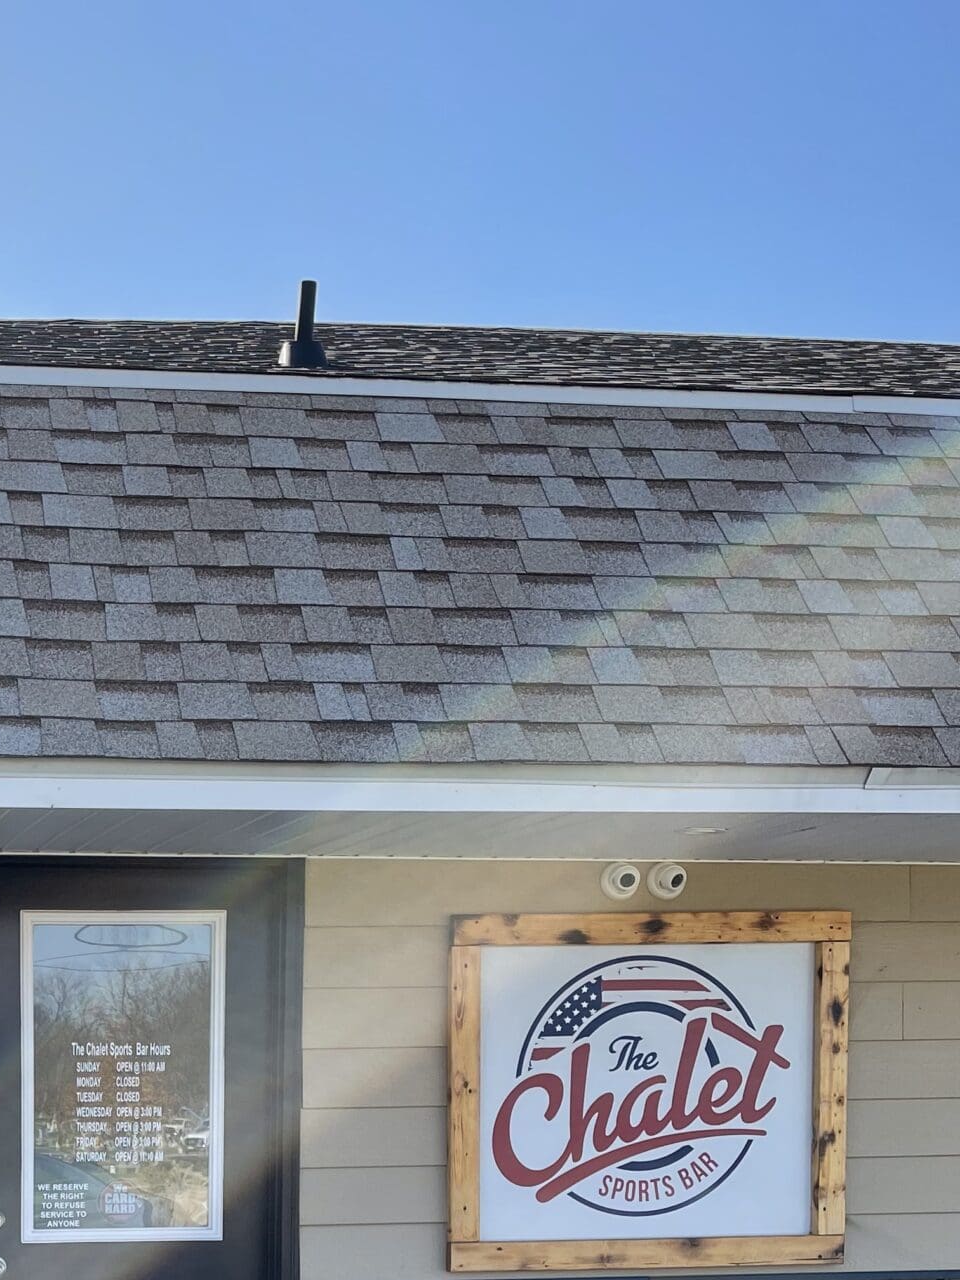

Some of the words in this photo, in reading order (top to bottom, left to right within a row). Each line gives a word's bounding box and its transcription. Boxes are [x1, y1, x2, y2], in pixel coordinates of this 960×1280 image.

[71, 1042, 85, 1056] The
[86, 1042, 109, 1056] Chalet
[109, 1042, 133, 1059] Sports
[136, 1042, 149, 1056] Bar
[149, 1042, 171, 1056] Hours
[608, 1035, 660, 1072] The
[76, 1062, 101, 1072] SUNDAY
[116, 1062, 133, 1072] OPEN
[141, 1062, 155, 1072] 11:00
[156, 1062, 166, 1072] AM
[76, 1077, 102, 1087] MONDAY
[115, 1077, 140, 1087] CLOSED
[76, 1092, 104, 1102] TUESDAY
[115, 1092, 140, 1102] CLOSED
[492, 1012, 791, 1190] Chalet
[76, 1106, 113, 1117] WEDNESDAY
[116, 1106, 133, 1117] OPEN
[153, 1106, 162, 1117] PM
[76, 1121, 107, 1132] THURSDAY
[115, 1121, 132, 1132] OPEN
[152, 1121, 161, 1132] PM
[75, 1136, 96, 1147] FRIDAY
[114, 1136, 131, 1147] OPEN
[151, 1136, 161, 1147] PM
[76, 1151, 107, 1162] SATURDAY
[115, 1151, 132, 1162] OPEN
[154, 1151, 164, 1162] AM
[598, 1174, 676, 1203] SPORTS
[679, 1151, 720, 1191] BAR
[37, 1183, 50, 1191] WE
[52, 1183, 89, 1191] RESERVE
[112, 1183, 128, 1193] We
[60, 1192, 85, 1200] RIGHT
[104, 1192, 136, 1204] CARD
[42, 1202, 53, 1210] TO
[54, 1201, 86, 1209] REFUSE
[104, 1203, 136, 1214] HARD
[40, 1211, 74, 1219] SERVICE
[76, 1210, 87, 1218] TO
[46, 1220, 81, 1228] ANYONE
